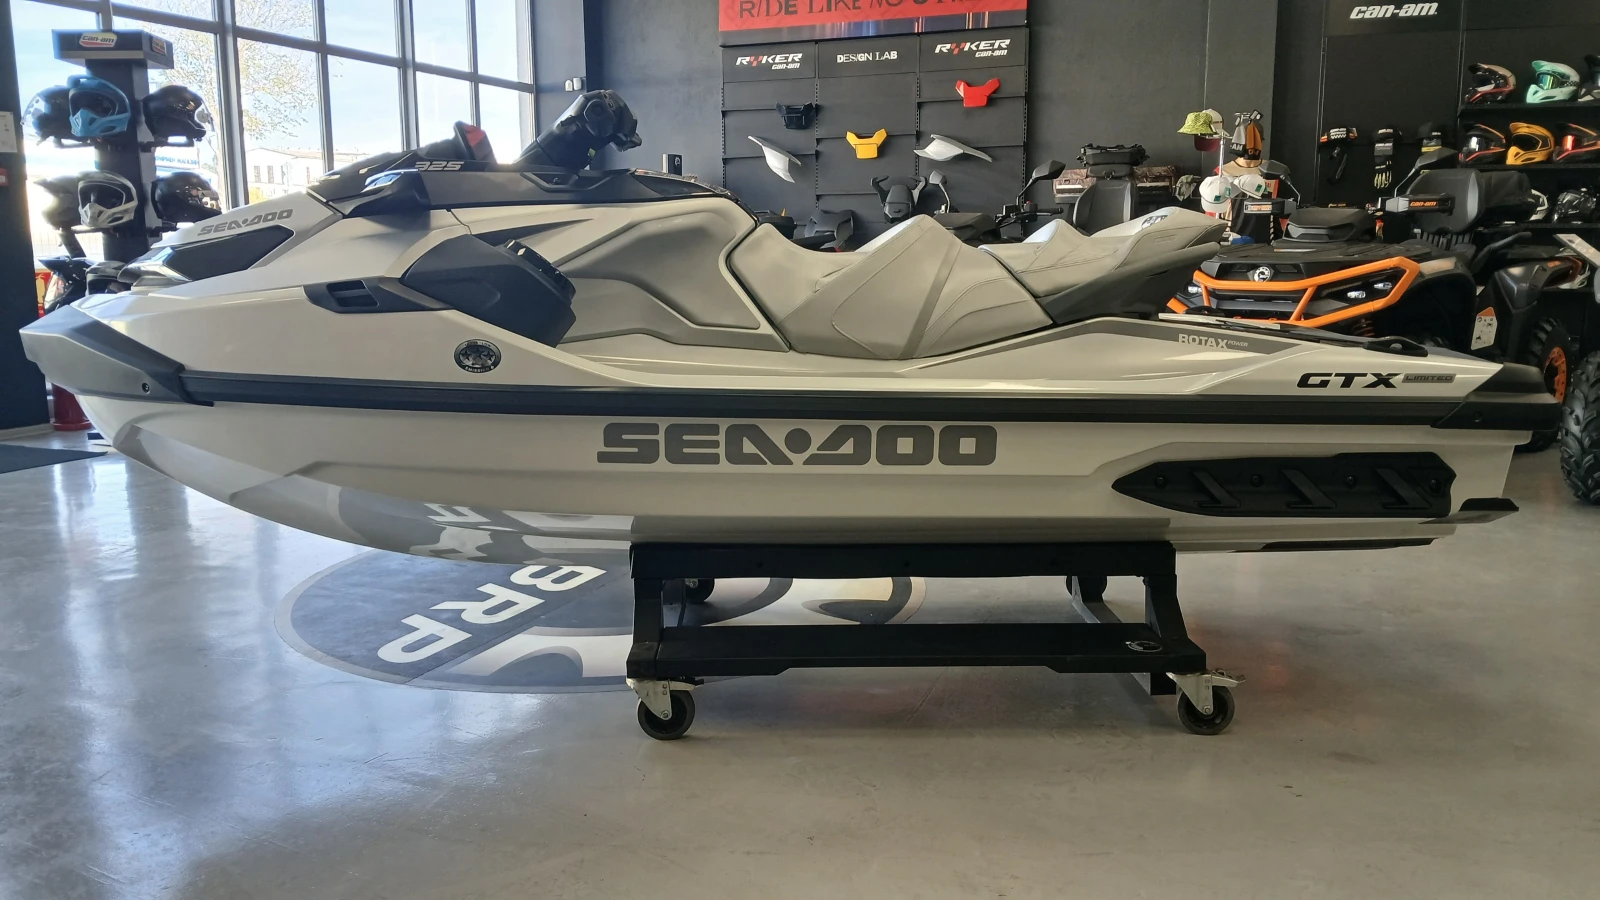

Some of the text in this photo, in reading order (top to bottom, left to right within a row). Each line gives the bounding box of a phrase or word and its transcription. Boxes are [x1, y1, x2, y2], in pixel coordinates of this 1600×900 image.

[739, 0, 798, 18] RIDE
[935, 39, 1011, 54] RYKER
[735, 53, 802, 66] RYKER
[837, 51, 898, 63] DESIGN LAB
[415, 161, 465, 170] 325
[1178, 334, 1228, 350] ROTAX
[1297, 373, 1403, 388] GTX
[377, 565, 608, 663] BRP
